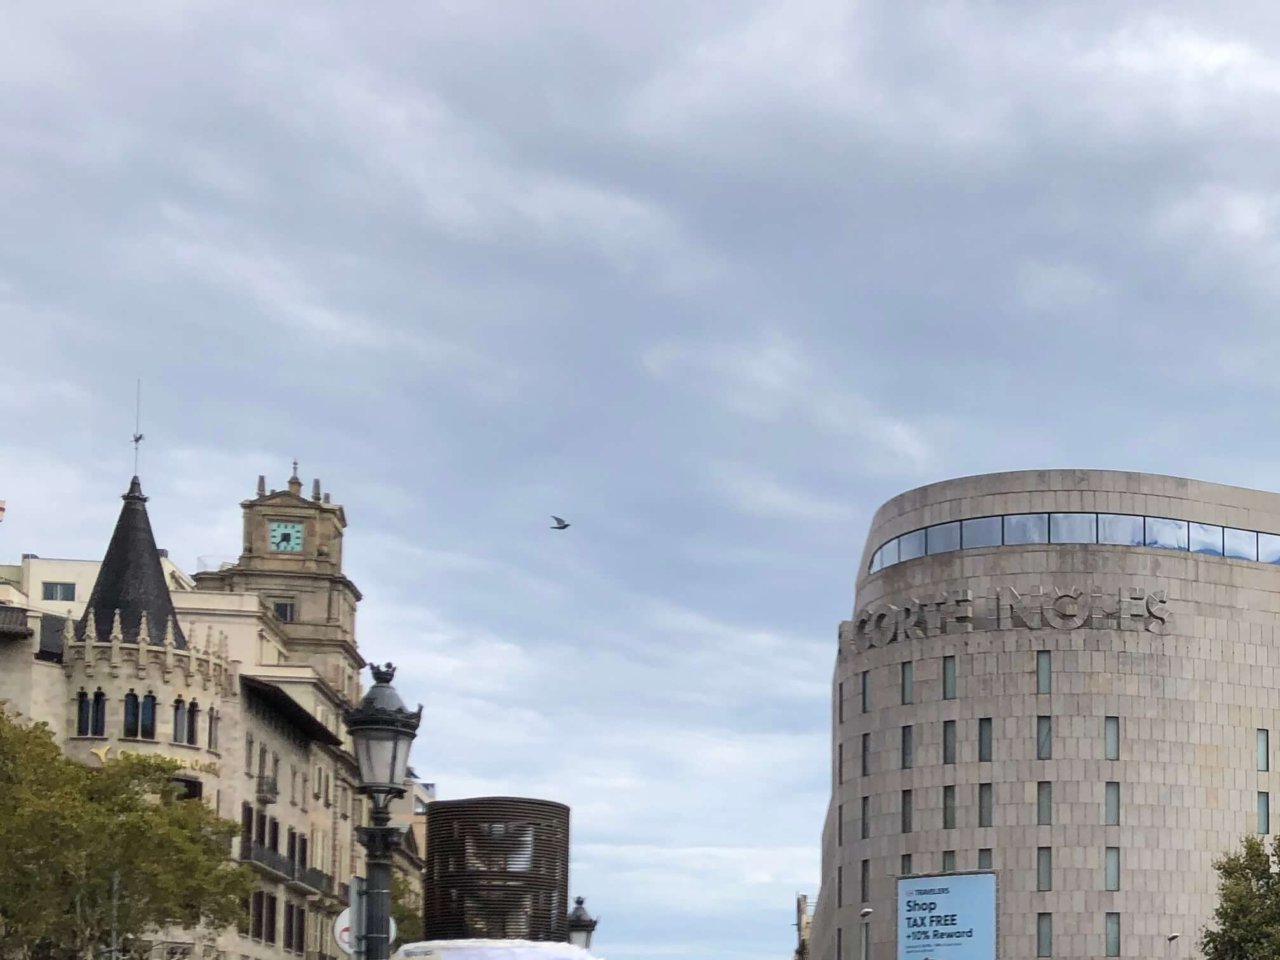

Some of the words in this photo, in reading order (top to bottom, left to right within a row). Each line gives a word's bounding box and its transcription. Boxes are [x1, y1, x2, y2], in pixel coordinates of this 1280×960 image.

[906, 900, 937, 913] Shop
[905, 916, 927, 928] TAX
[929, 914, 957, 927] FREE
[906, 930, 930, 940] +10%
[932, 928, 973, 939] Reward
